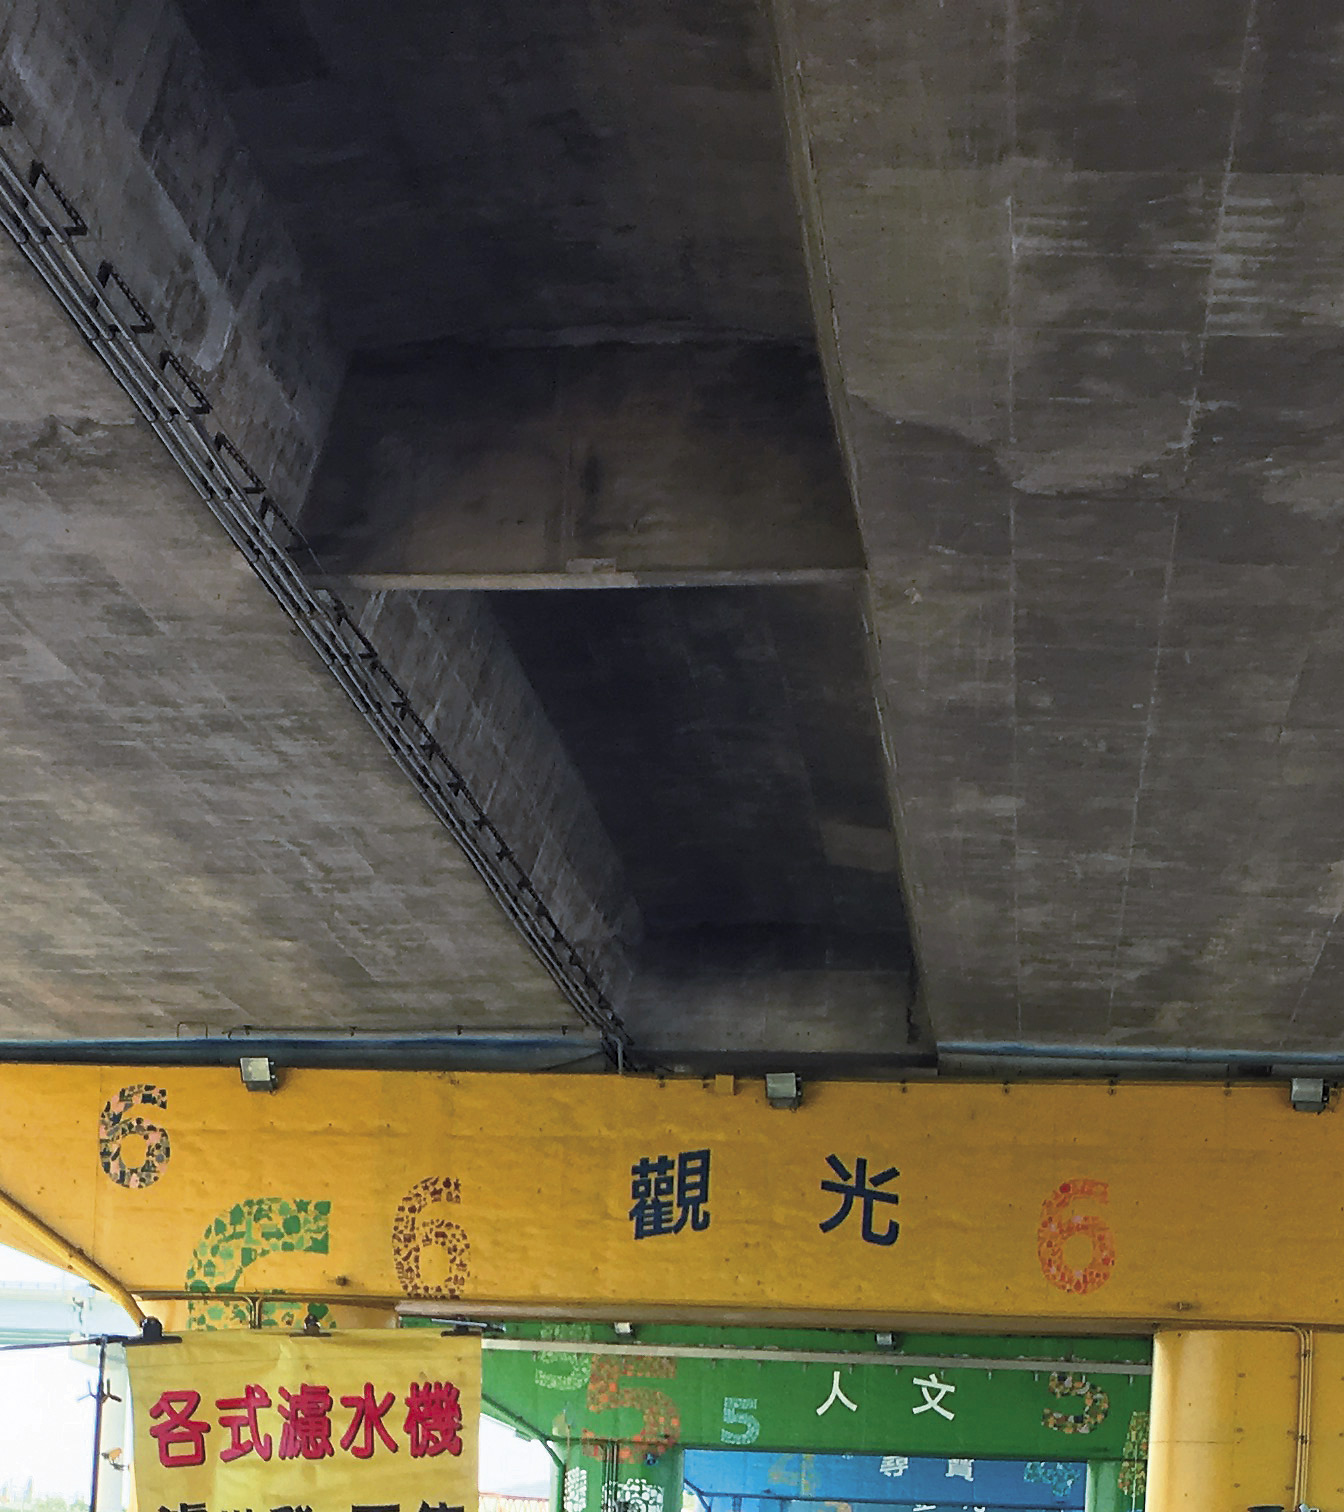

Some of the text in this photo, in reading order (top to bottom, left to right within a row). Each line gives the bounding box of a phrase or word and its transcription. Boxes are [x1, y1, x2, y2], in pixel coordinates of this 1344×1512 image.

[99, 1084, 172, 1188] 6
[392, 1176, 471, 1300] 6
[629, 1148, 900, 1247] 觀光
[1037, 1178, 1116, 1295] 6
[149, 1381, 464, 1468] 各式濾水機
[581, 1354, 681, 1464] 5
[721, 1397, 760, 1445] 5
[816, 1370, 957, 1421] 人文
